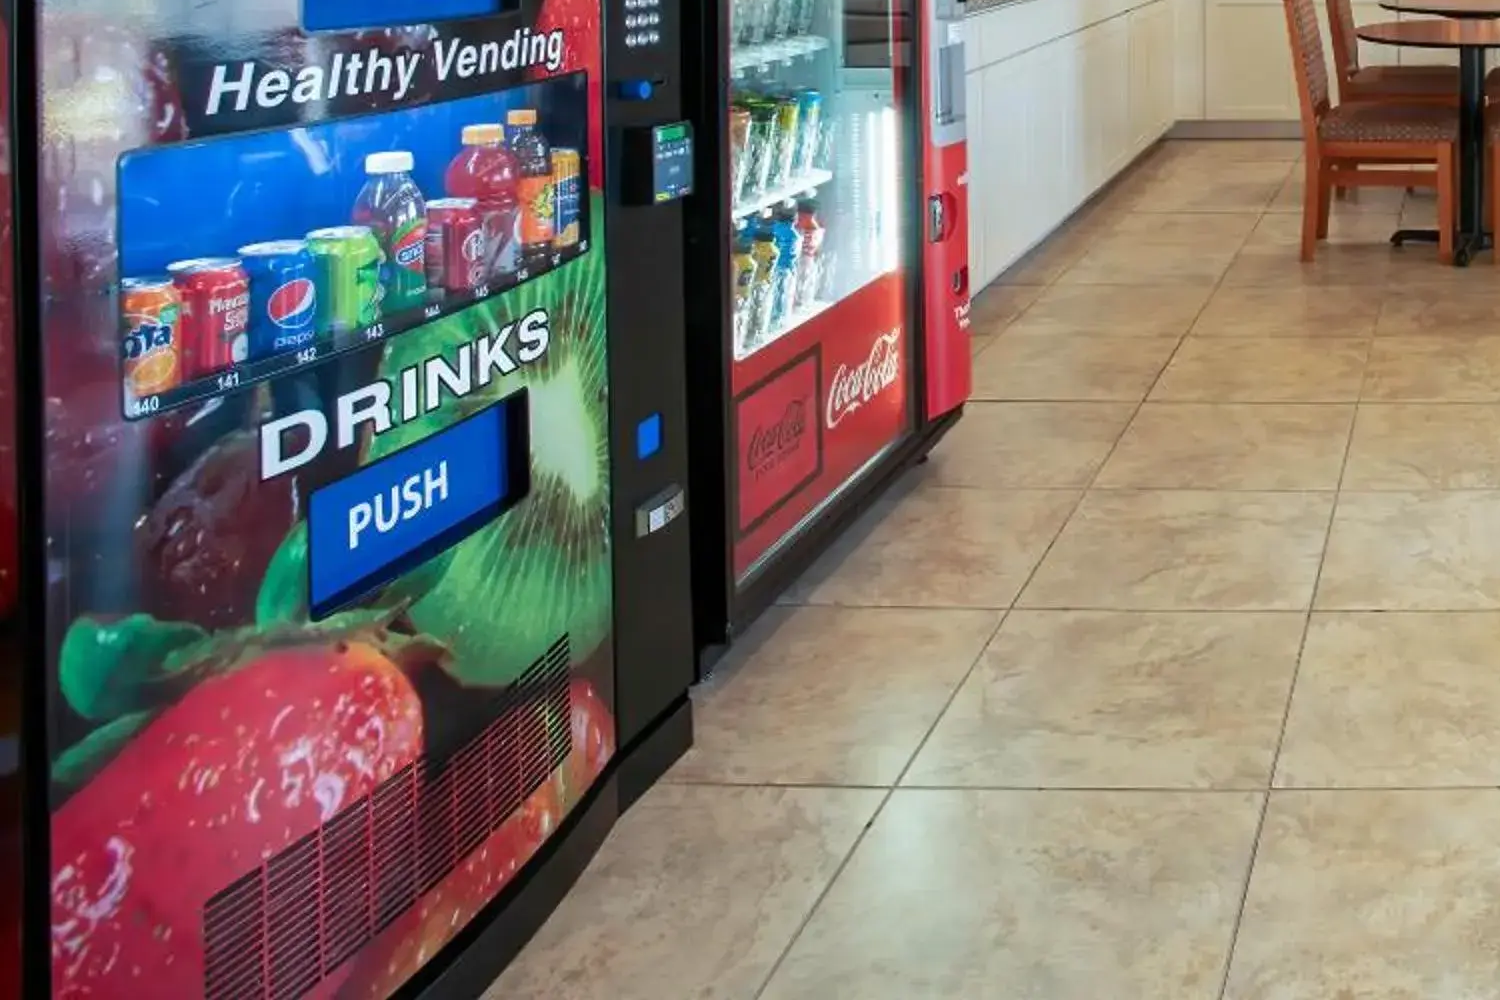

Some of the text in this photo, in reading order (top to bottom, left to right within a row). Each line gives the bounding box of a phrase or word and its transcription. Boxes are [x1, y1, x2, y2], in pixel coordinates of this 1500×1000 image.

[205, 27, 563, 115] Healthy Vending
[297, 347, 318, 364] 142
[366, 323, 385, 341] 143
[132, 396, 160, 416] 140
[217, 373, 240, 391] 141
[260, 309, 549, 481] DRINKS
[827, 328, 900, 429] Coca-Cola
[747, 393, 807, 473] Coca-Cola
[350, 460, 449, 550] PUSH
